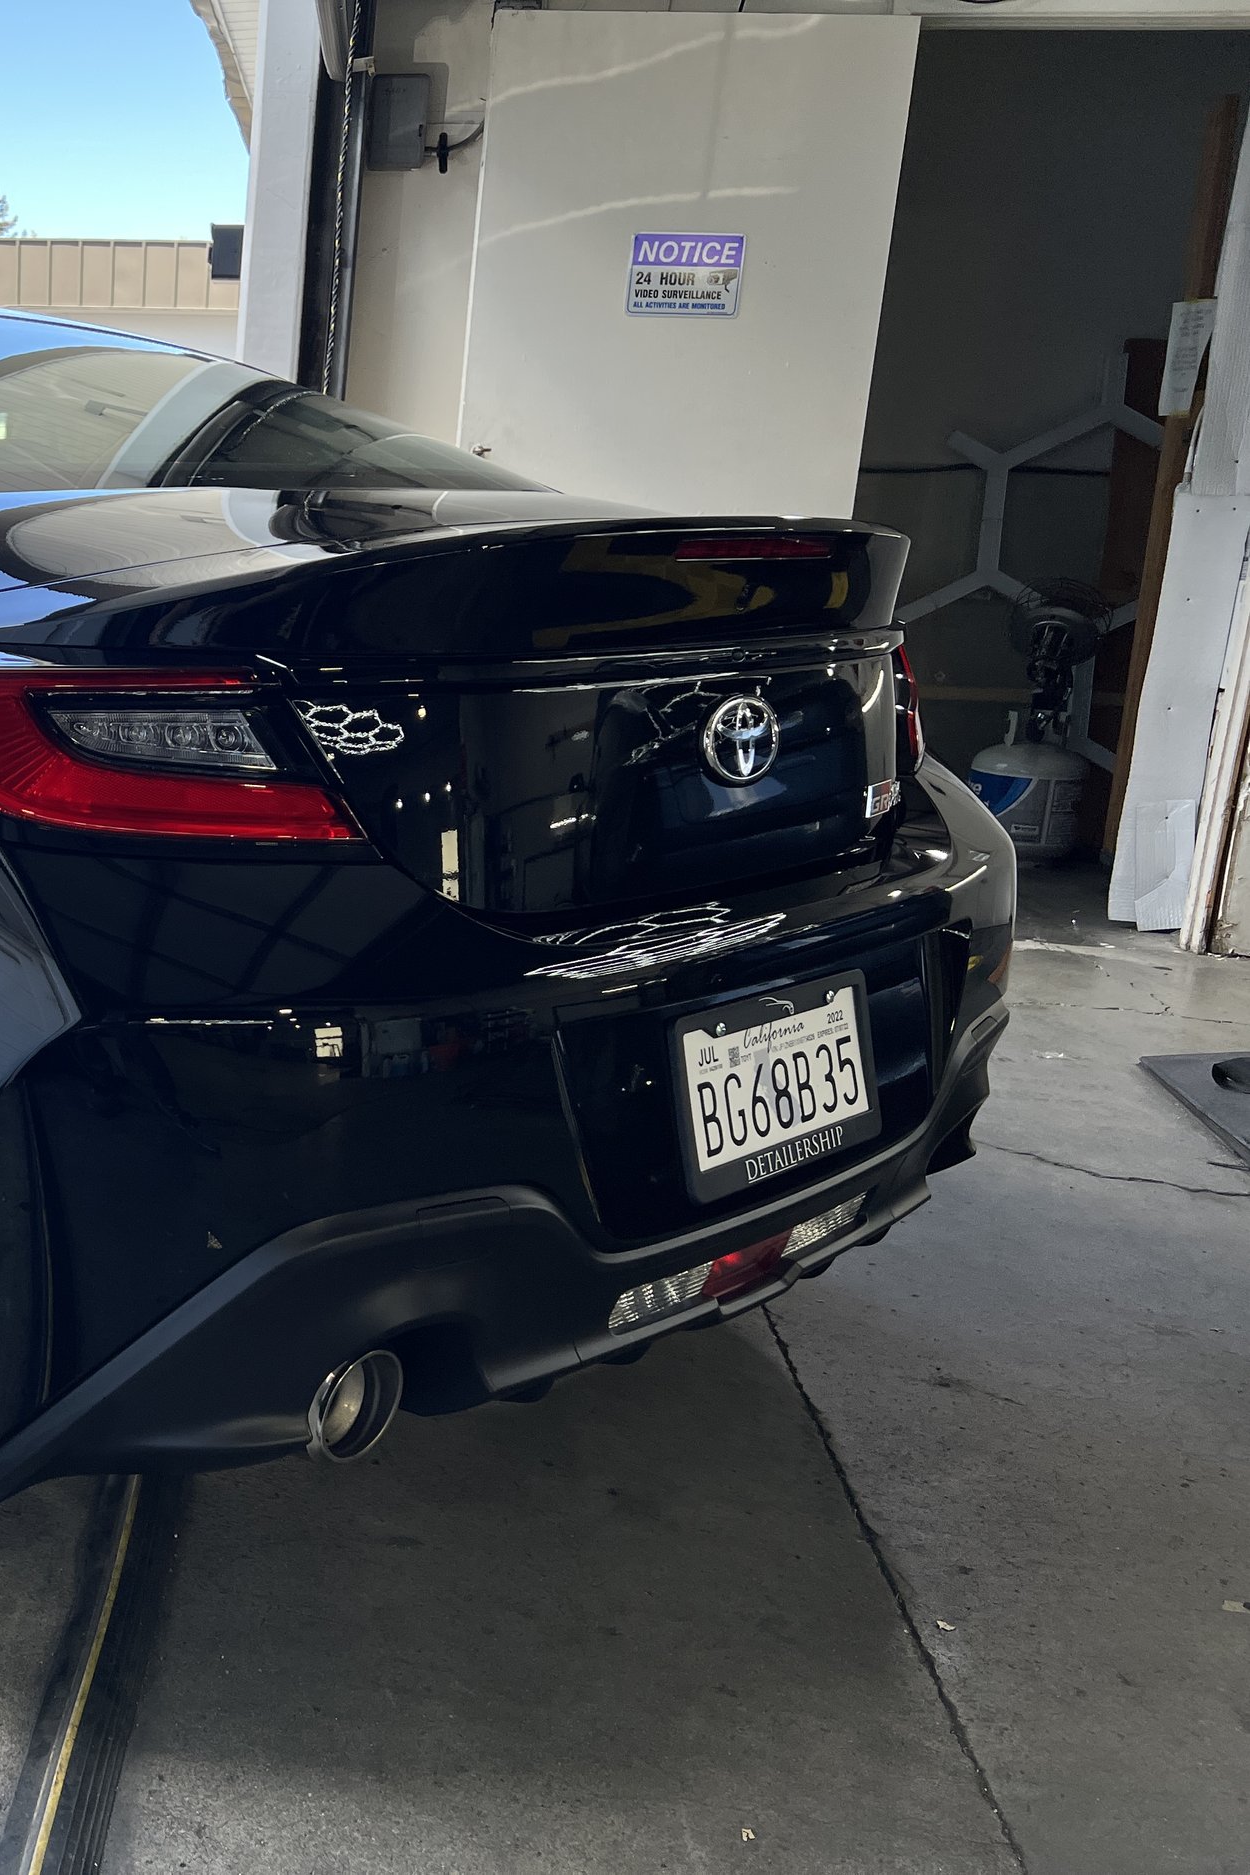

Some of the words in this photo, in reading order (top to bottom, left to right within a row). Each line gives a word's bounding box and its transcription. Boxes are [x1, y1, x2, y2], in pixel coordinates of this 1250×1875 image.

[638, 241, 739, 264] NOTICE
[635, 272, 651, 285] 24
[659, 272, 696, 286] HOUR
[634, 289, 659, 299] VIDEO
[661, 290, 722, 300] SURVEILLANCE
[871, 793, 889, 813] GR
[827, 1010, 844, 1024] 2022
[743, 1019, 805, 1053] California
[698, 1046, 719, 1067] JUL
[697, 1035, 859, 1158] BG68B35
[745, 1126, 843, 1182] DETAILERSHIP
